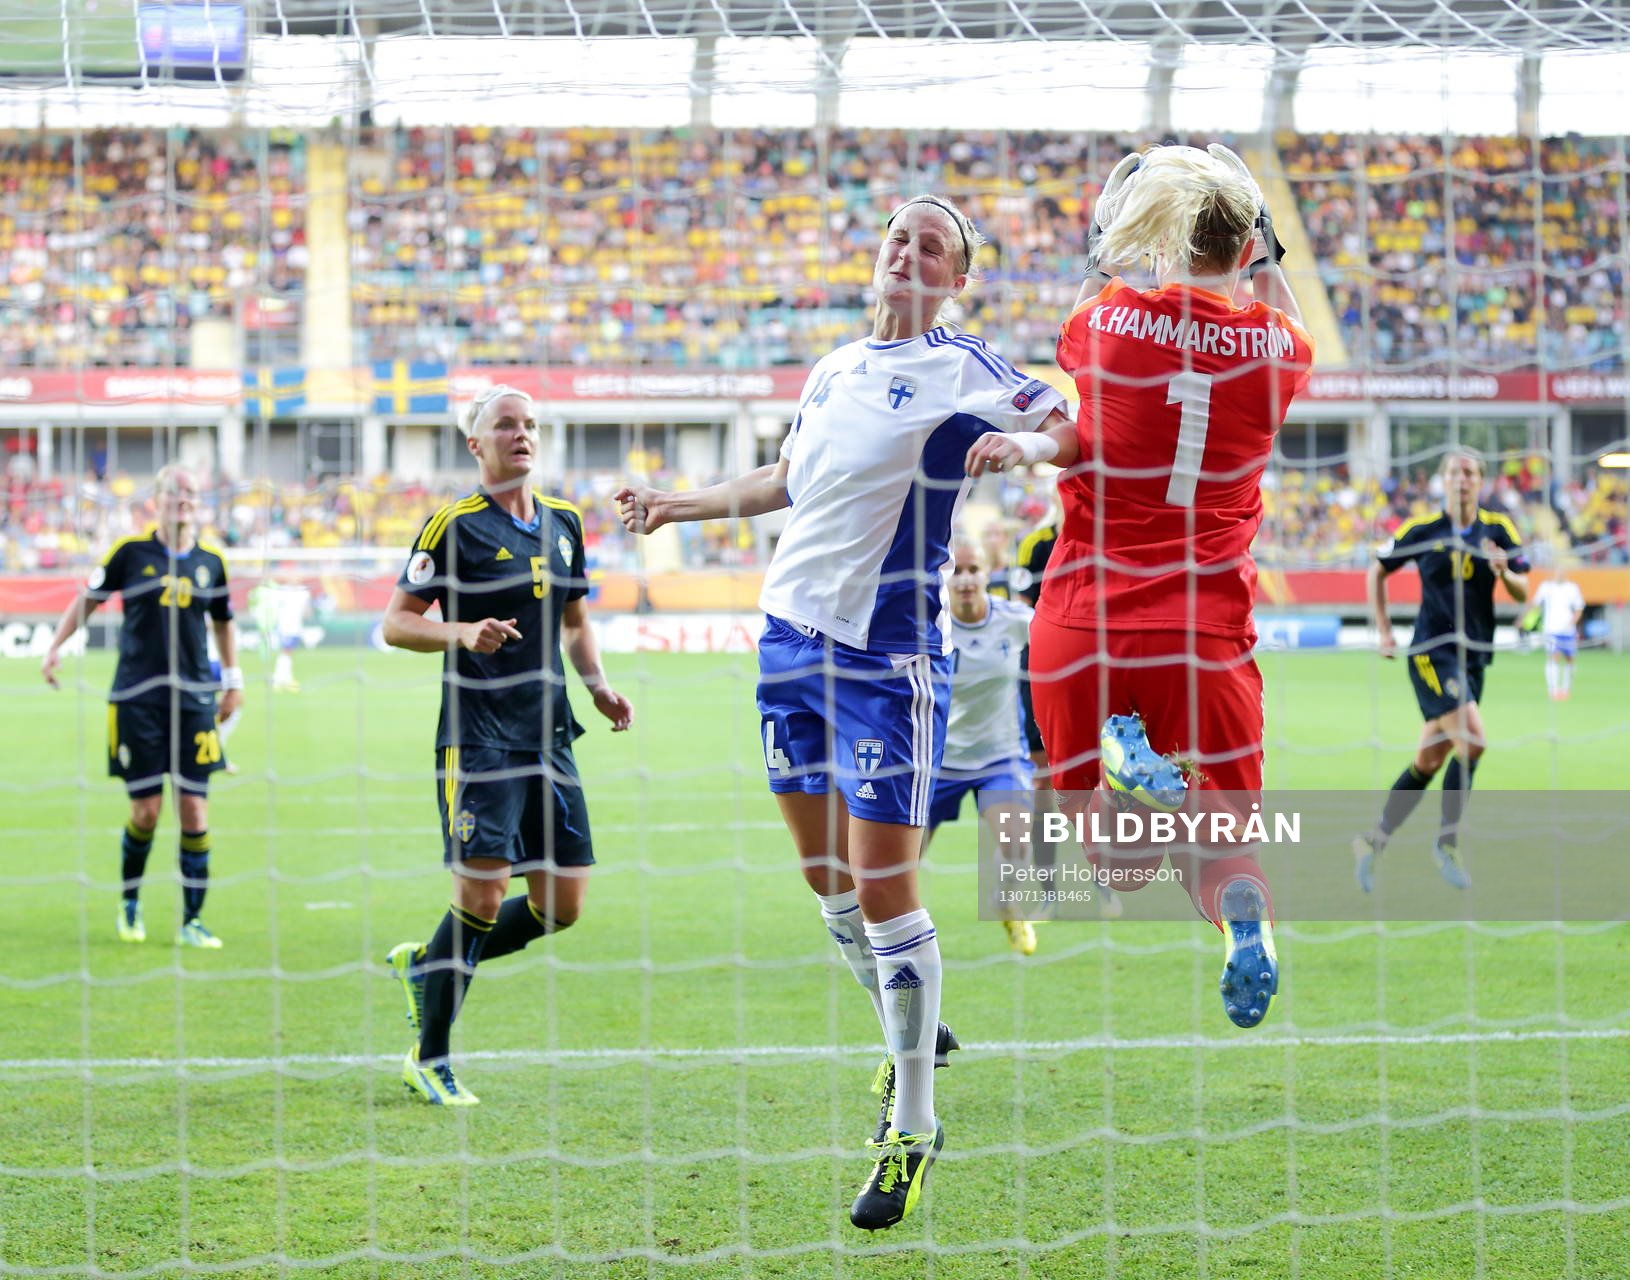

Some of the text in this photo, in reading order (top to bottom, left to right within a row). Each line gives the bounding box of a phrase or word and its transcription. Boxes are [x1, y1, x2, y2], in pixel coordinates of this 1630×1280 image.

[1087, 304, 1295, 359] K.HAMMARSTRÖM
[1165, 371, 1214, 508] 1
[529, 555, 550, 600] 5
[1451, 551, 1475, 581] 16
[159, 575, 193, 609] 20
[194, 728, 222, 765] 20
[765, 721, 792, 776] 4
[884, 980, 925, 990] adidas
